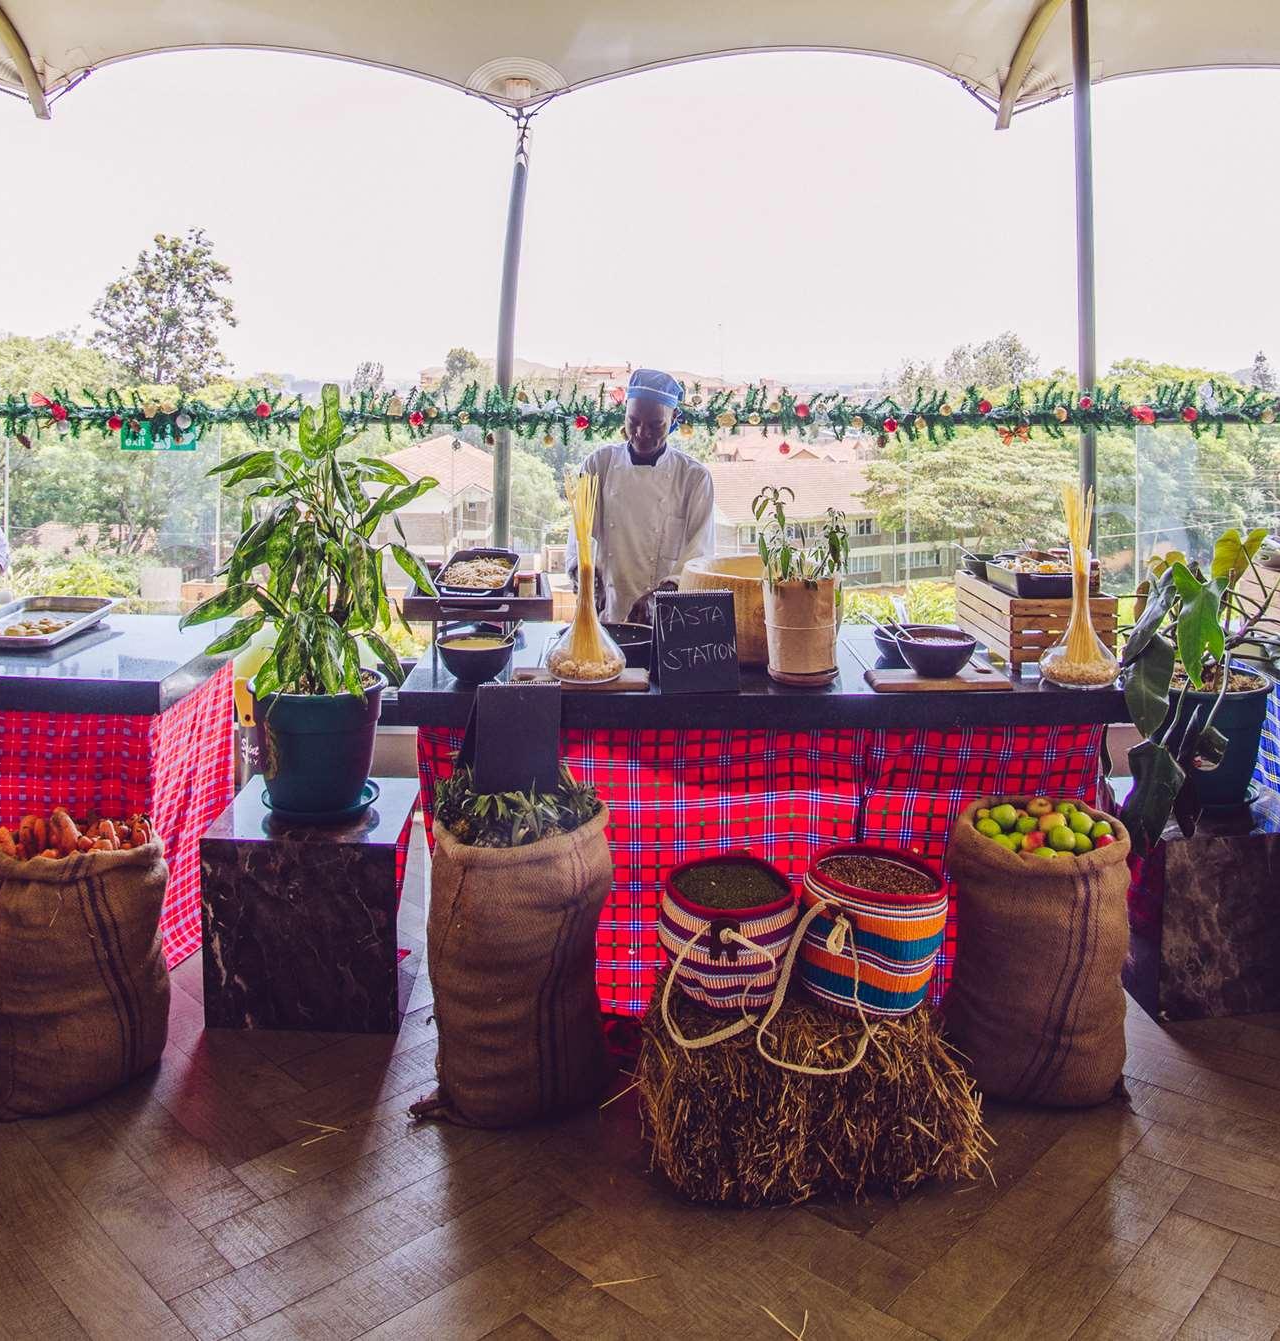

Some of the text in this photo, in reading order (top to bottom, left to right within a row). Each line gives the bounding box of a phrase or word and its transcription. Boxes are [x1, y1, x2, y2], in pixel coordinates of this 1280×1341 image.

[125, 435, 146, 447] exit
[655, 602, 723, 643] PASTA
[663, 635, 737, 671] STATION
